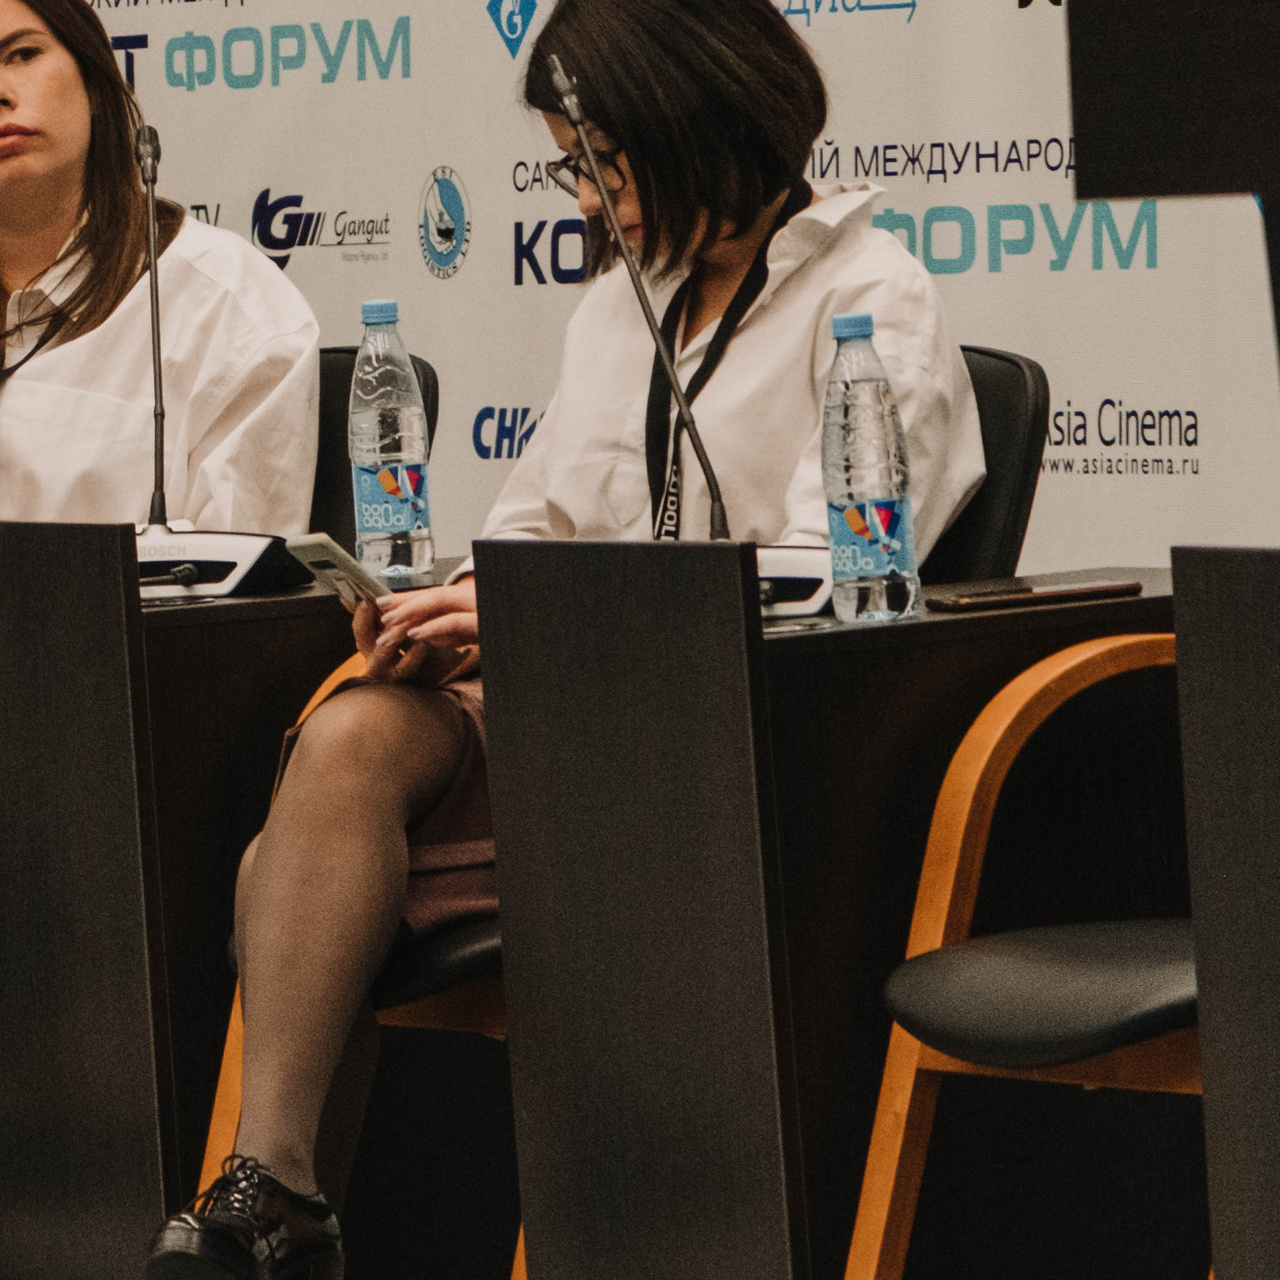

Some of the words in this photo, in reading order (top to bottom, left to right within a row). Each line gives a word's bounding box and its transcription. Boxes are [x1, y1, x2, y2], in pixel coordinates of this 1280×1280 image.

[165, 16, 411, 92] ФОРУМ
[854, 137, 1075, 184] МЕЖДУНАРО
[334, 210, 390, 245] Gangut
[1047, 400, 1087, 446] sia
[1098, 399, 1198, 447] Cinema
[661, 495, 678, 541] DOL
